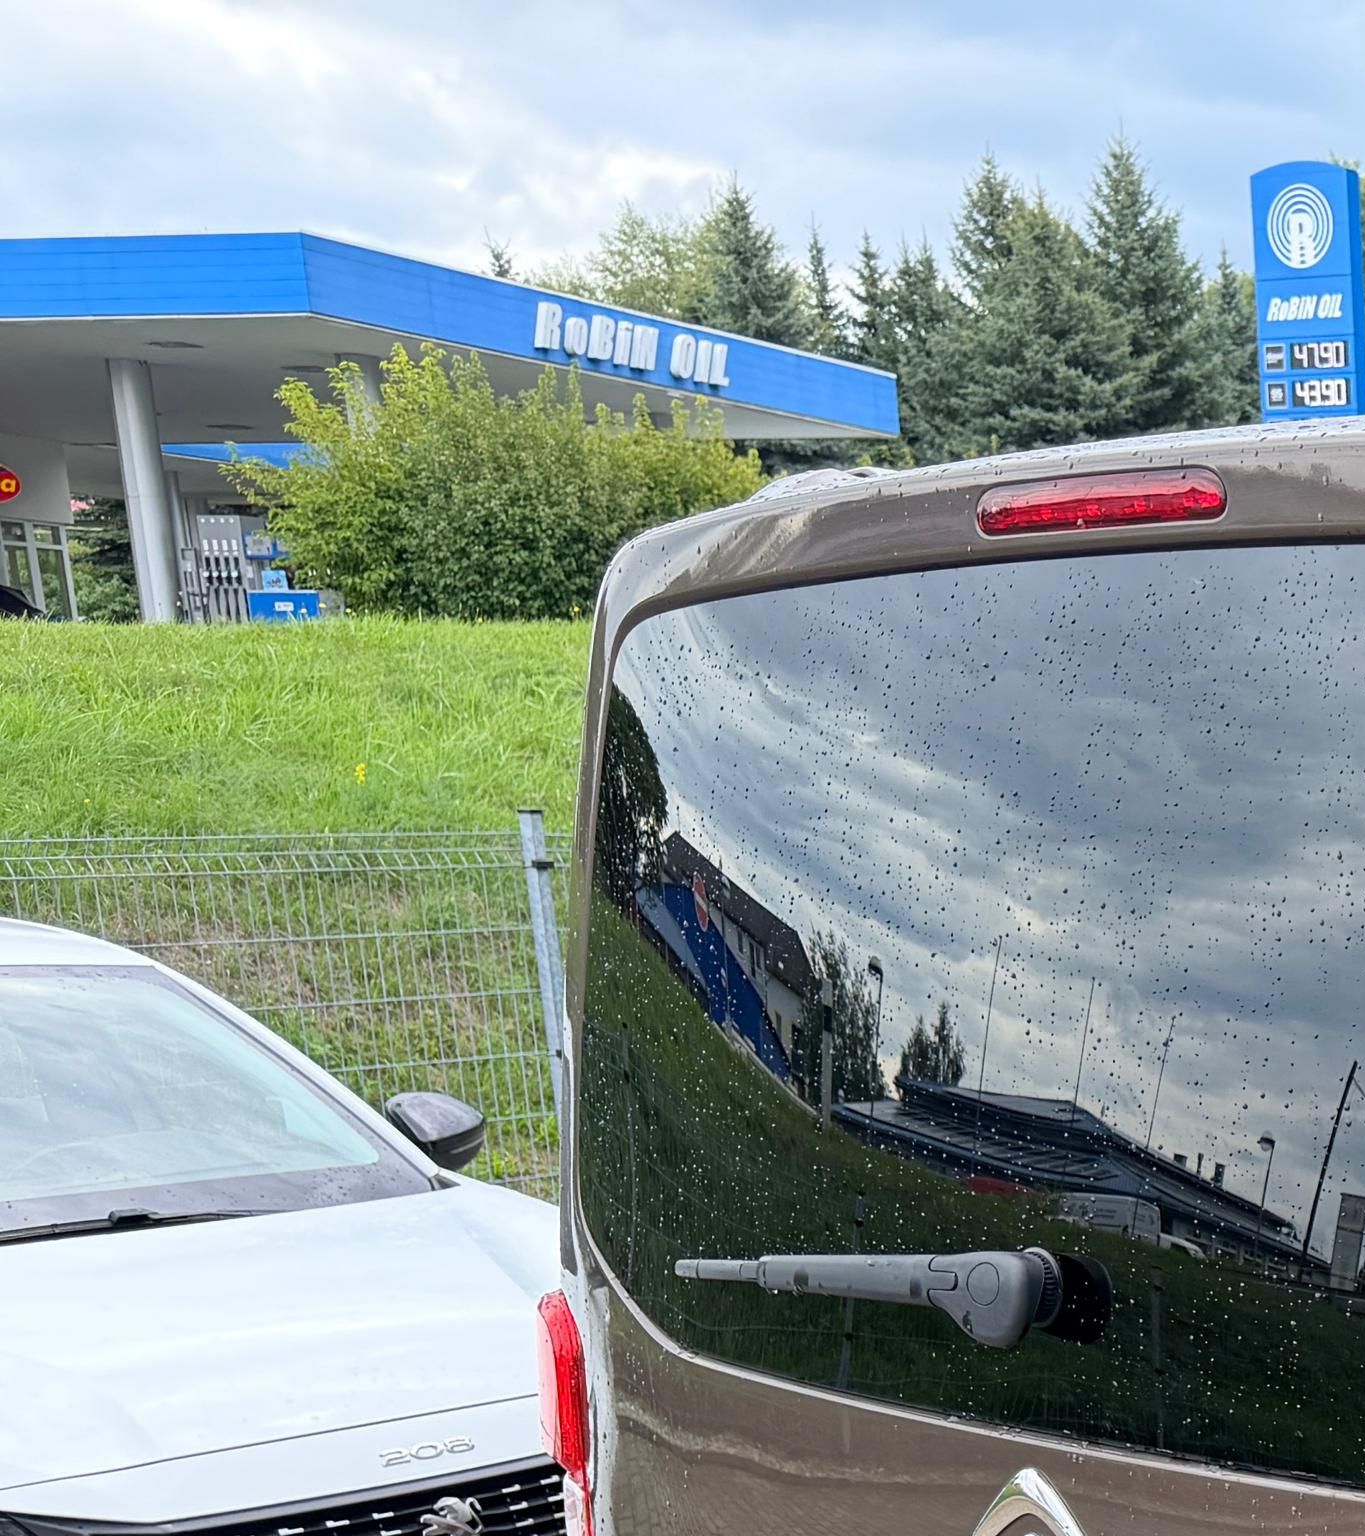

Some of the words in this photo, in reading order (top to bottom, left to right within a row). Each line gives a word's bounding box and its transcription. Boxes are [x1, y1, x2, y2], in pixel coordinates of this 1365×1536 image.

[1317, 294, 1343, 318] OIL
[670, 334, 730, 387] OIL
[379, 1435, 475, 1467] 208
